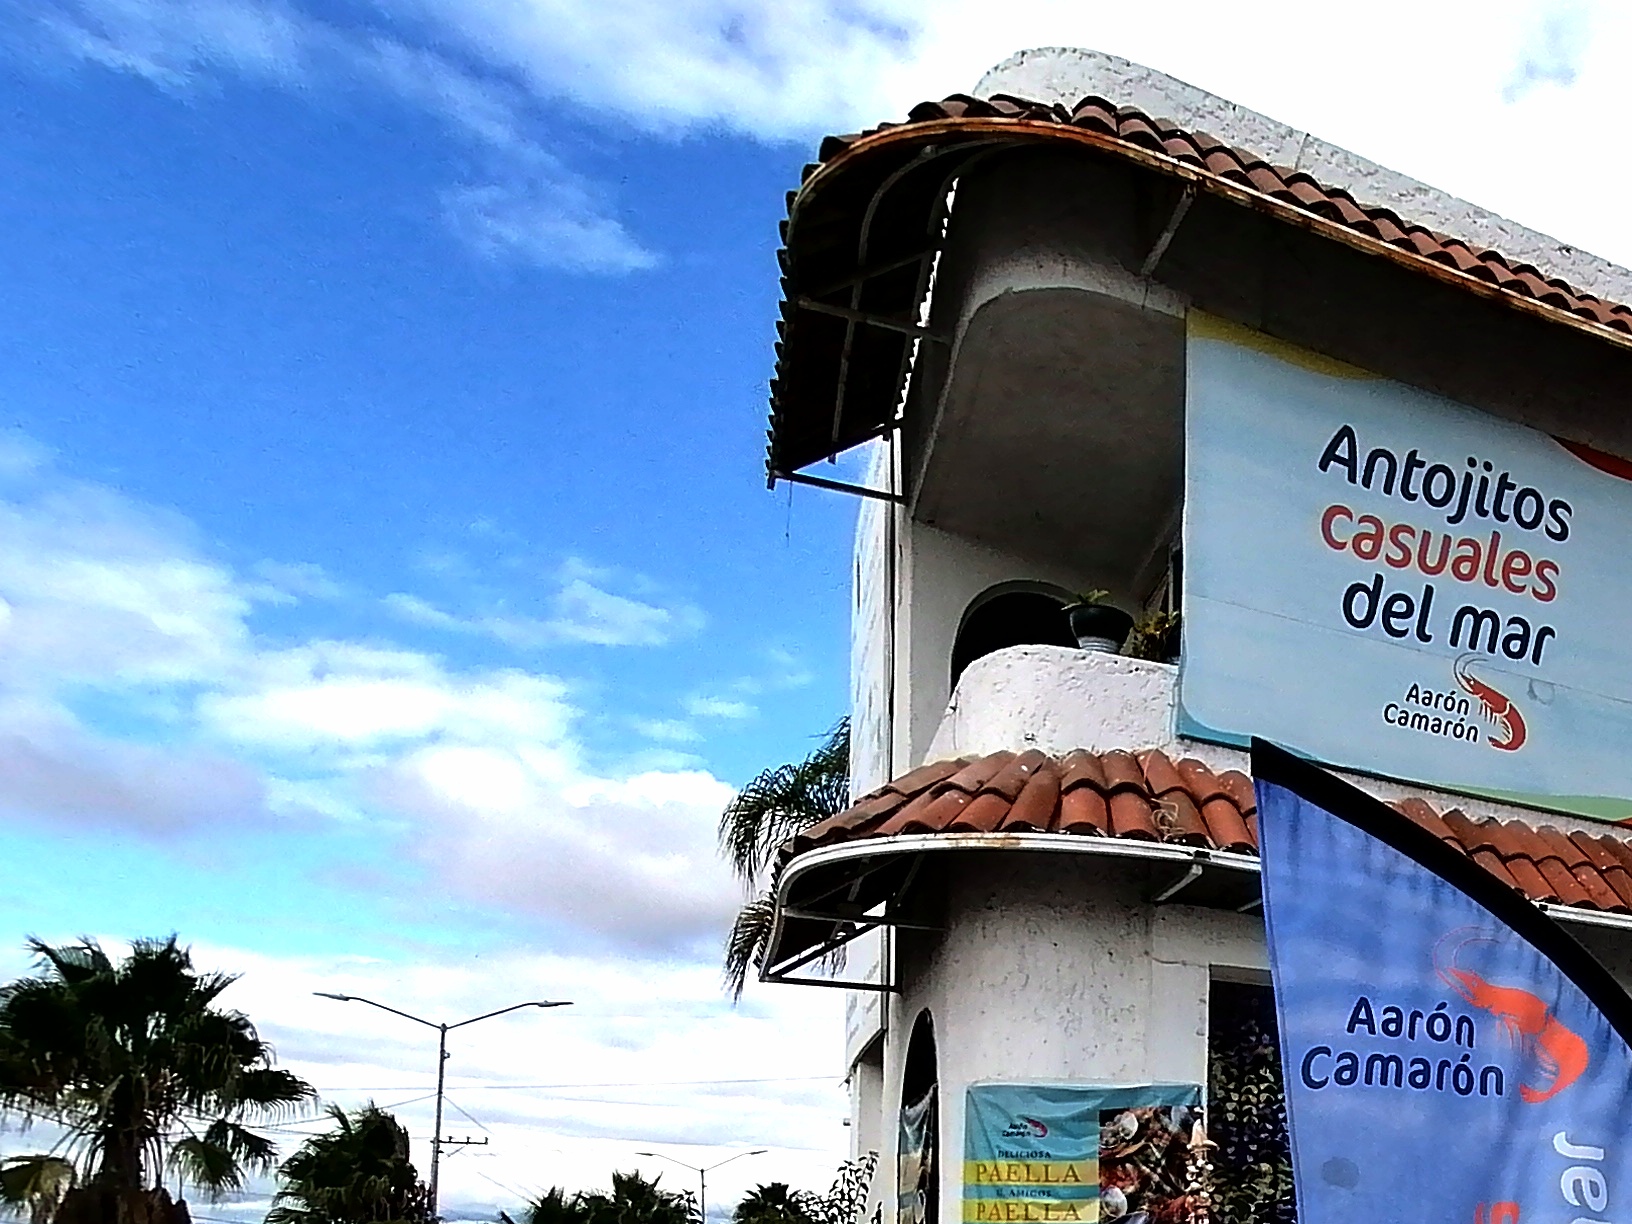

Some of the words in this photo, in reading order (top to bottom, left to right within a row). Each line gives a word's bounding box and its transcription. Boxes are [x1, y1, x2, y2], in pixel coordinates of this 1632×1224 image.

[1318, 424, 1573, 542] Antojitos
[1320, 504, 1560, 603] casuales
[1342, 572, 1435, 644] del
[1449, 605, 1556, 666] mar
[1405, 682, 1470, 716] Aarón
[1383, 703, 1479, 743] Camarón
[1346, 996, 1475, 1049] Aarón
[1301, 1045, 1504, 1096] Camarón
[975, 1163, 1081, 1183] PAELLA
[998, 1150, 1052, 1159] DELICIOSA
[976, 1202, 1082, 1222] PAELLA
